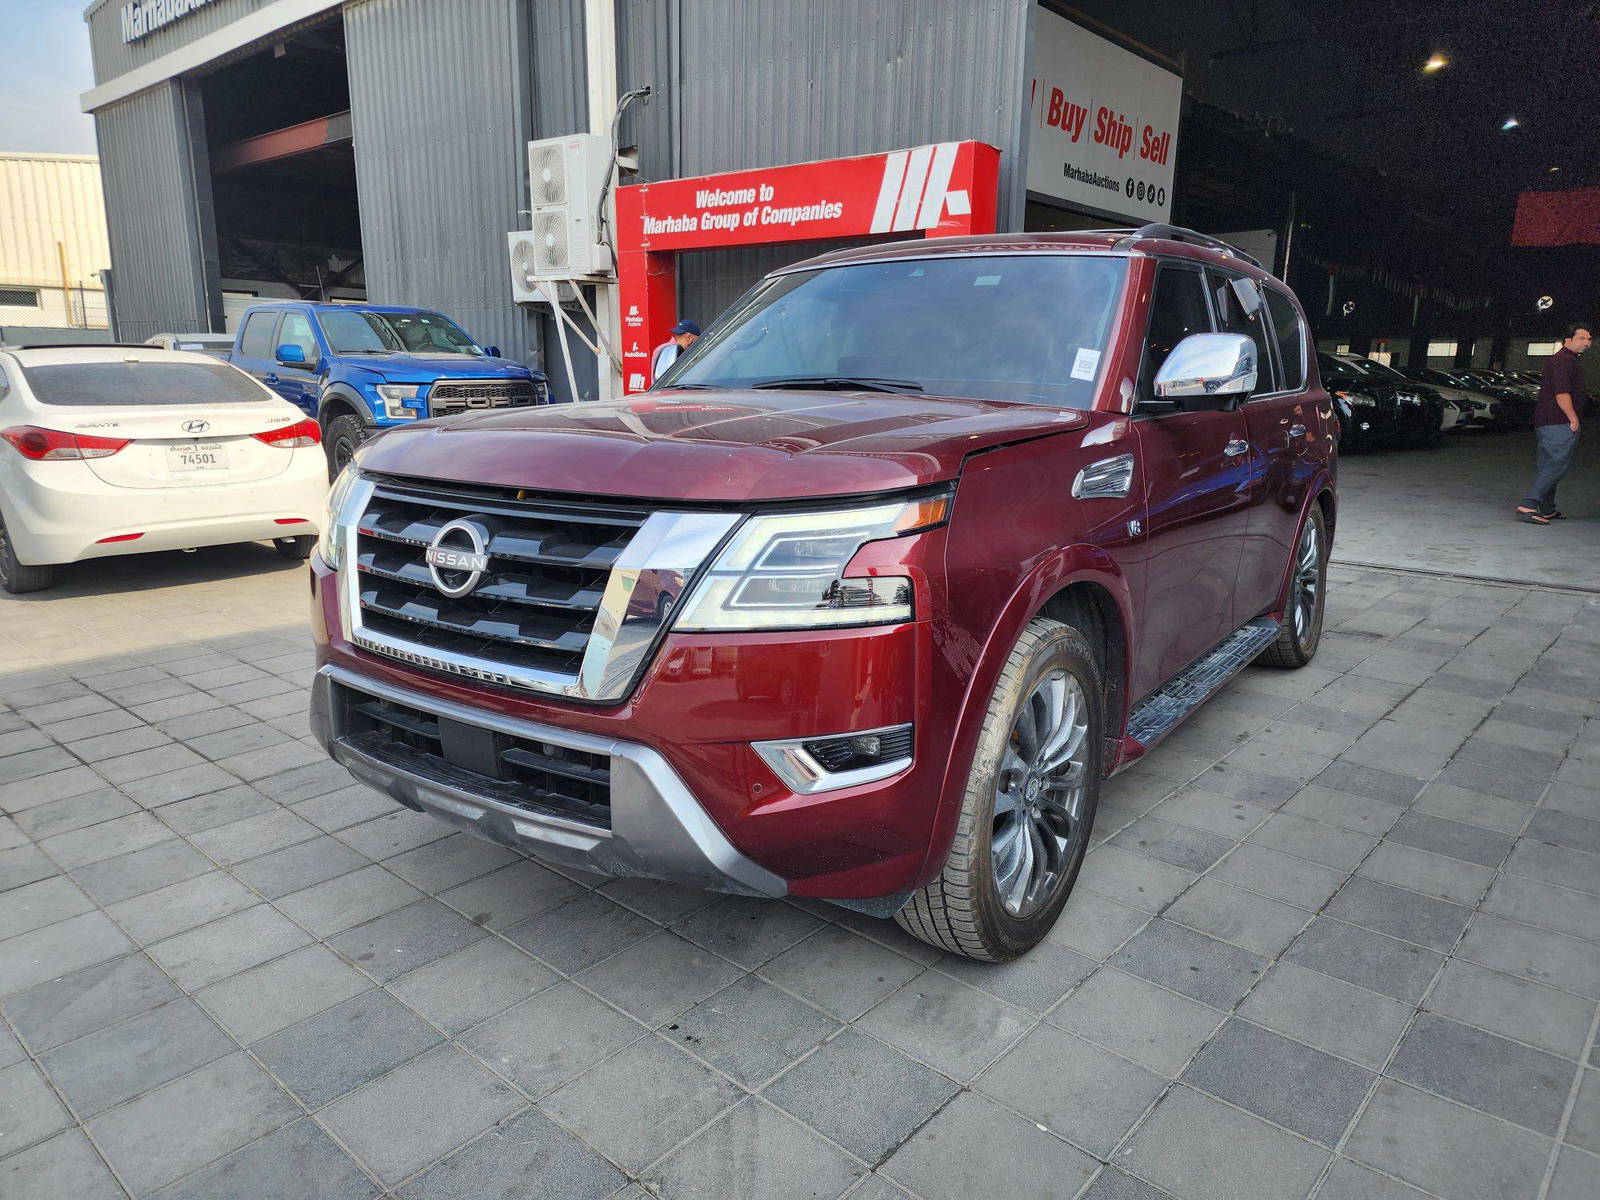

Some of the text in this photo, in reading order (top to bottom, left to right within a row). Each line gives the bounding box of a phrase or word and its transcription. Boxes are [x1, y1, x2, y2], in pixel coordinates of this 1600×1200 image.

[1047, 87, 1088, 143] Buy
[1094, 106, 1133, 160] Ship
[1140, 125, 1171, 166] Sell
[1063, 163, 1120, 192] MarhabaAuctions
[695, 183, 775, 209] Welcome to
[643, 200, 844, 235] Marhaba Group of Companies
[180, 453, 217, 465] 74501
[425, 549, 485, 571] NISSAN
